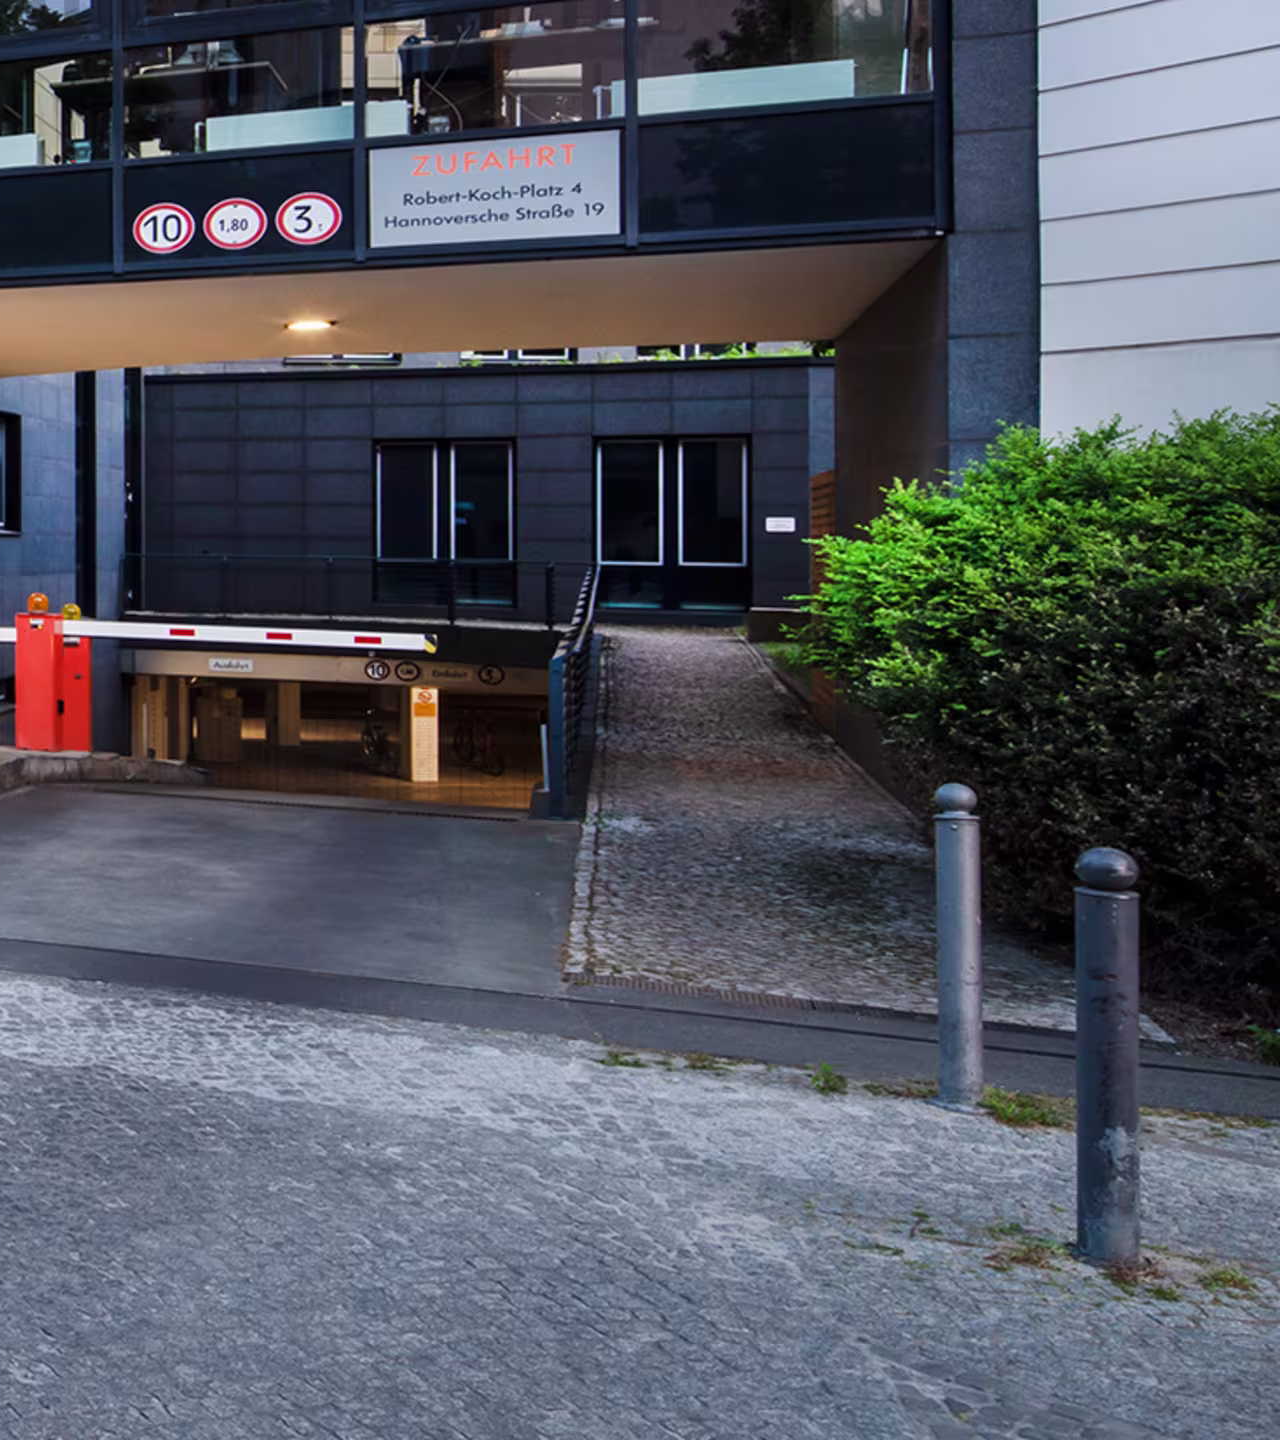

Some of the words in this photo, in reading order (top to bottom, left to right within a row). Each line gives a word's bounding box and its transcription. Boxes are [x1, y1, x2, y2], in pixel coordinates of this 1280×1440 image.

[411, 143, 577, 177] ZUFAHRT
[402, 184, 564, 207] Robert-Koch-Platz
[570, 182, 583, 195] 4
[143, 213, 182, 243] 10
[293, 205, 313, 233] 3
[384, 208, 510, 229] Hannoversche
[515, 203, 575, 221] Straße
[583, 202, 605, 217] 19
